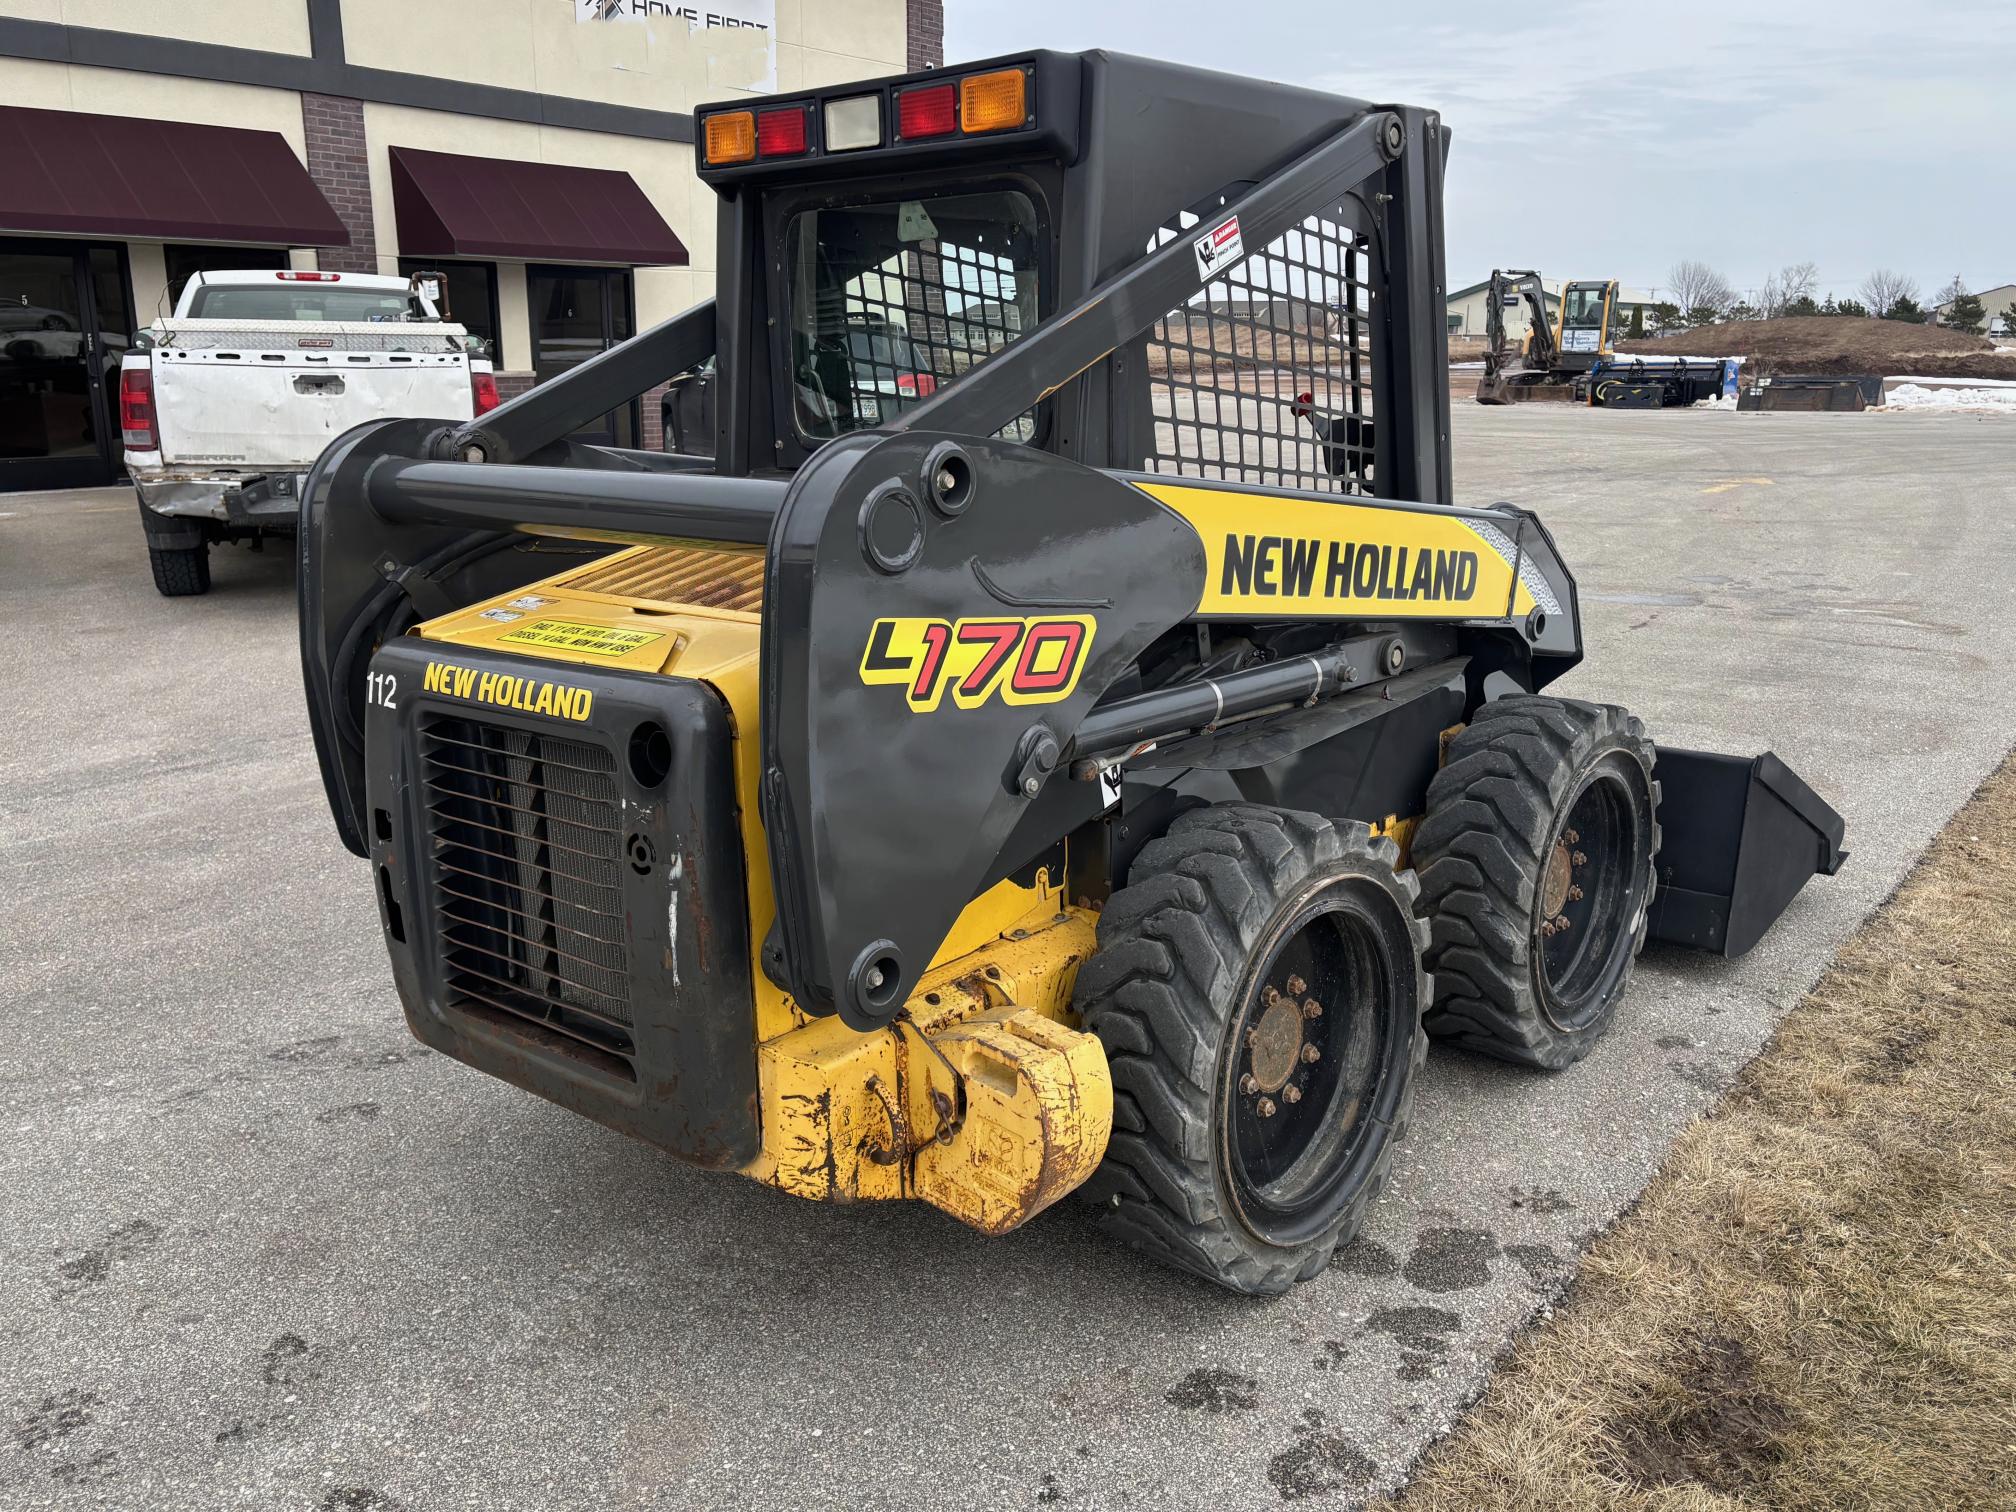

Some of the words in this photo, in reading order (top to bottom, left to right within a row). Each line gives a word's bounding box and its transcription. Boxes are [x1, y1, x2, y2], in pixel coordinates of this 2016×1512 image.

[706, 13, 768, 31] FIR
[21, 294, 28, 306] 5
[1220, 533, 1320, 598] NEW
[1324, 541, 1479, 602] HOLLAND
[859, 614, 1097, 713] L170
[366, 671, 397, 709] 112
[423, 661, 479, 700] NEW
[477, 672, 593, 722] HOLLAND
